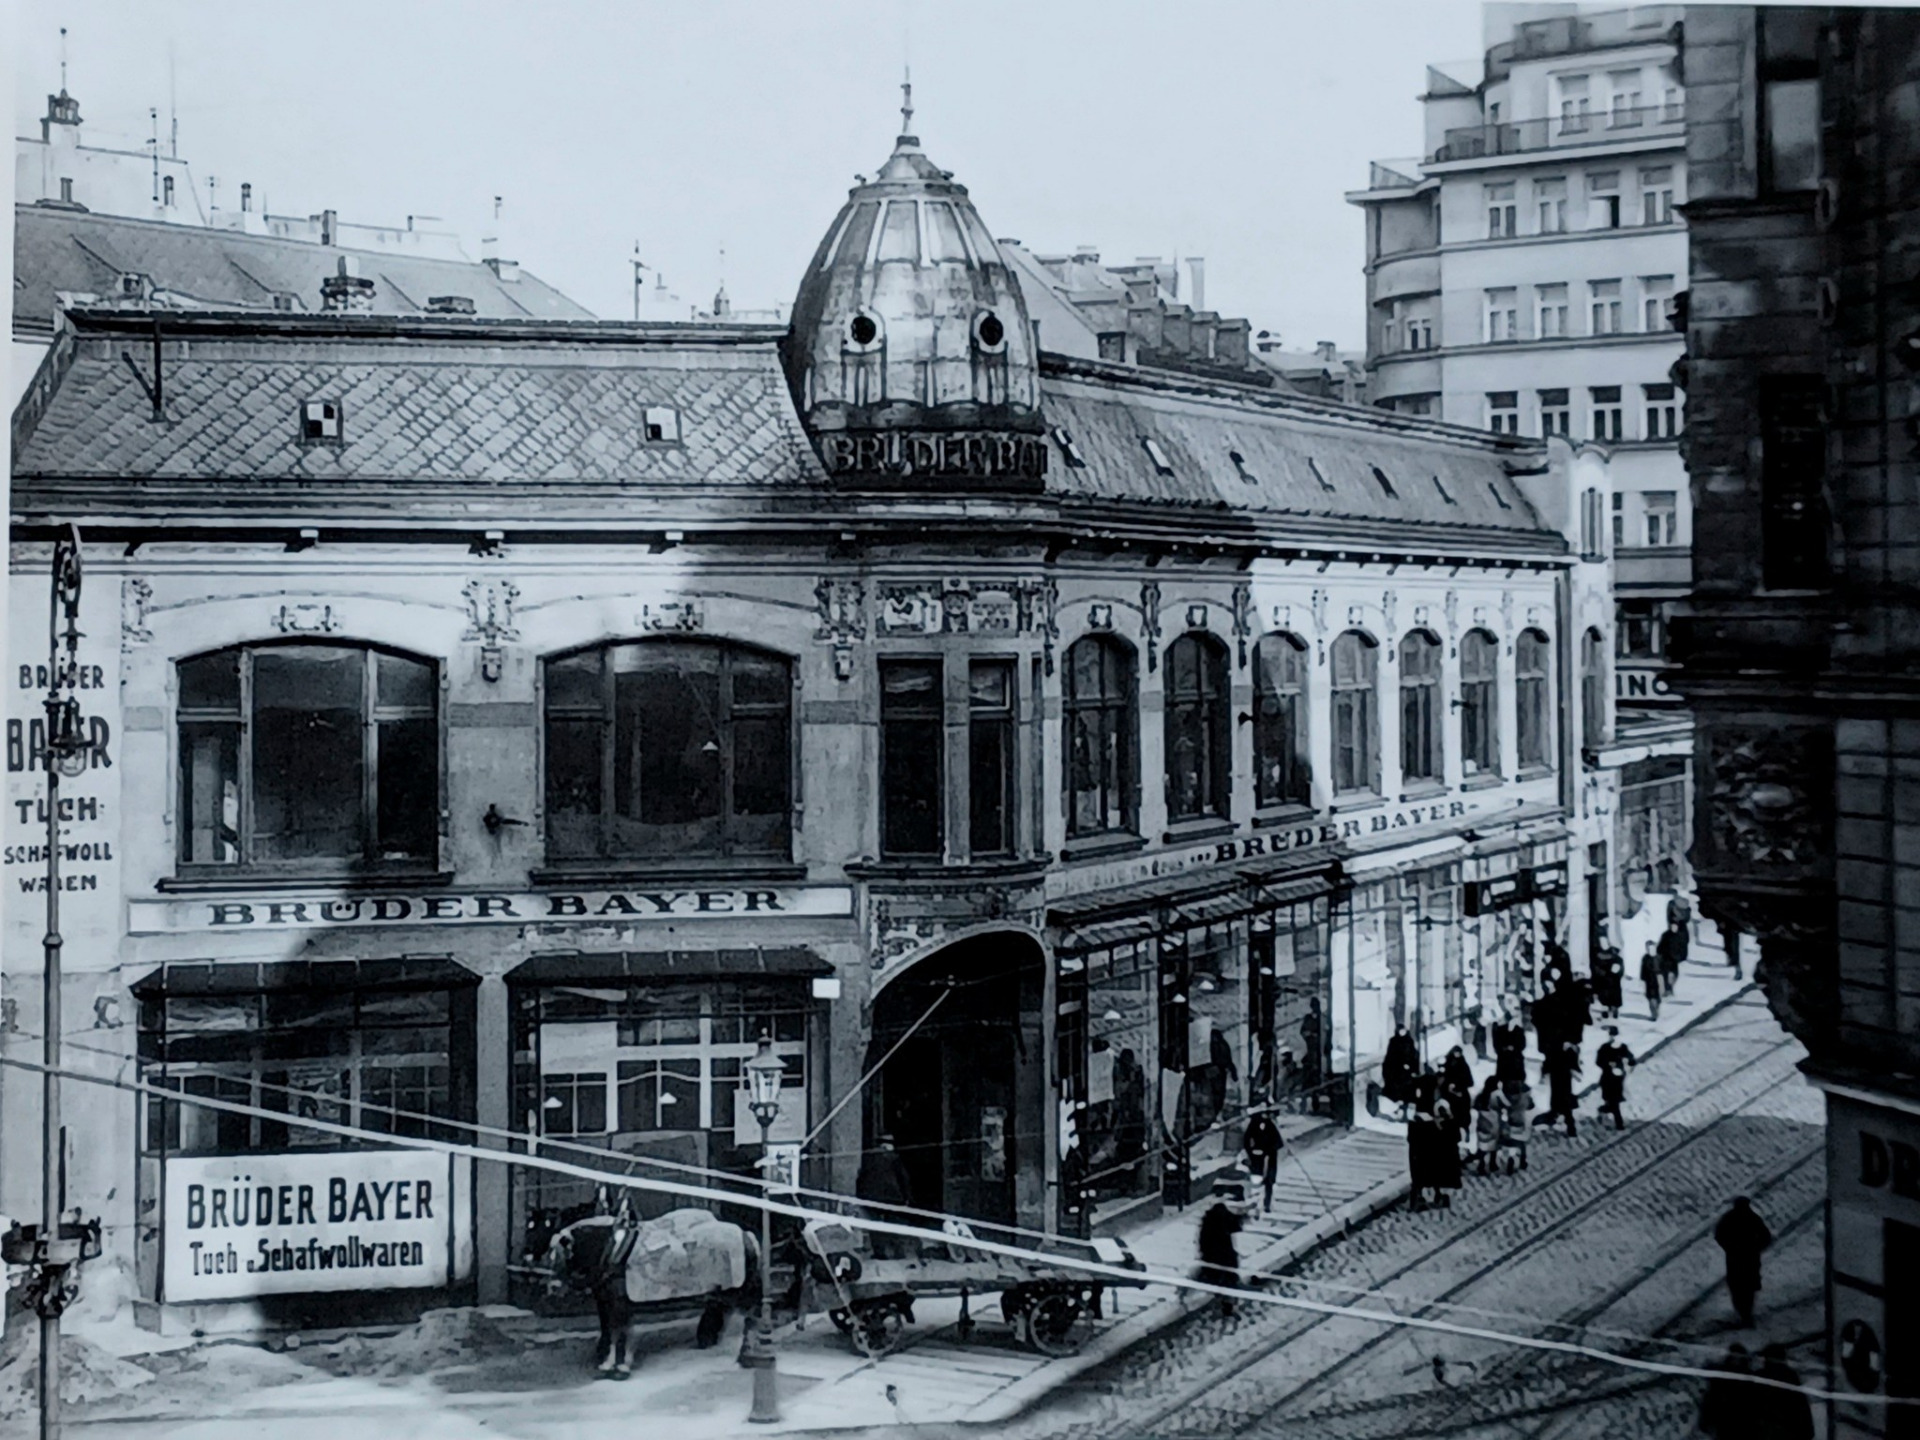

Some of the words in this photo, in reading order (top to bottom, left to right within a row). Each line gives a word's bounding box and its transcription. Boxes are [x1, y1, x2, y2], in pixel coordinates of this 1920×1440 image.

[1215, 820, 1361, 863] BRÜDER
[207, 896, 522, 926] BRÜDER
[547, 891, 785, 915] BAYER
[187, 1175, 317, 1229] BRÜDER
[328, 1177, 434, 1223] BAYER
[190, 1241, 238, 1276] Tuch
